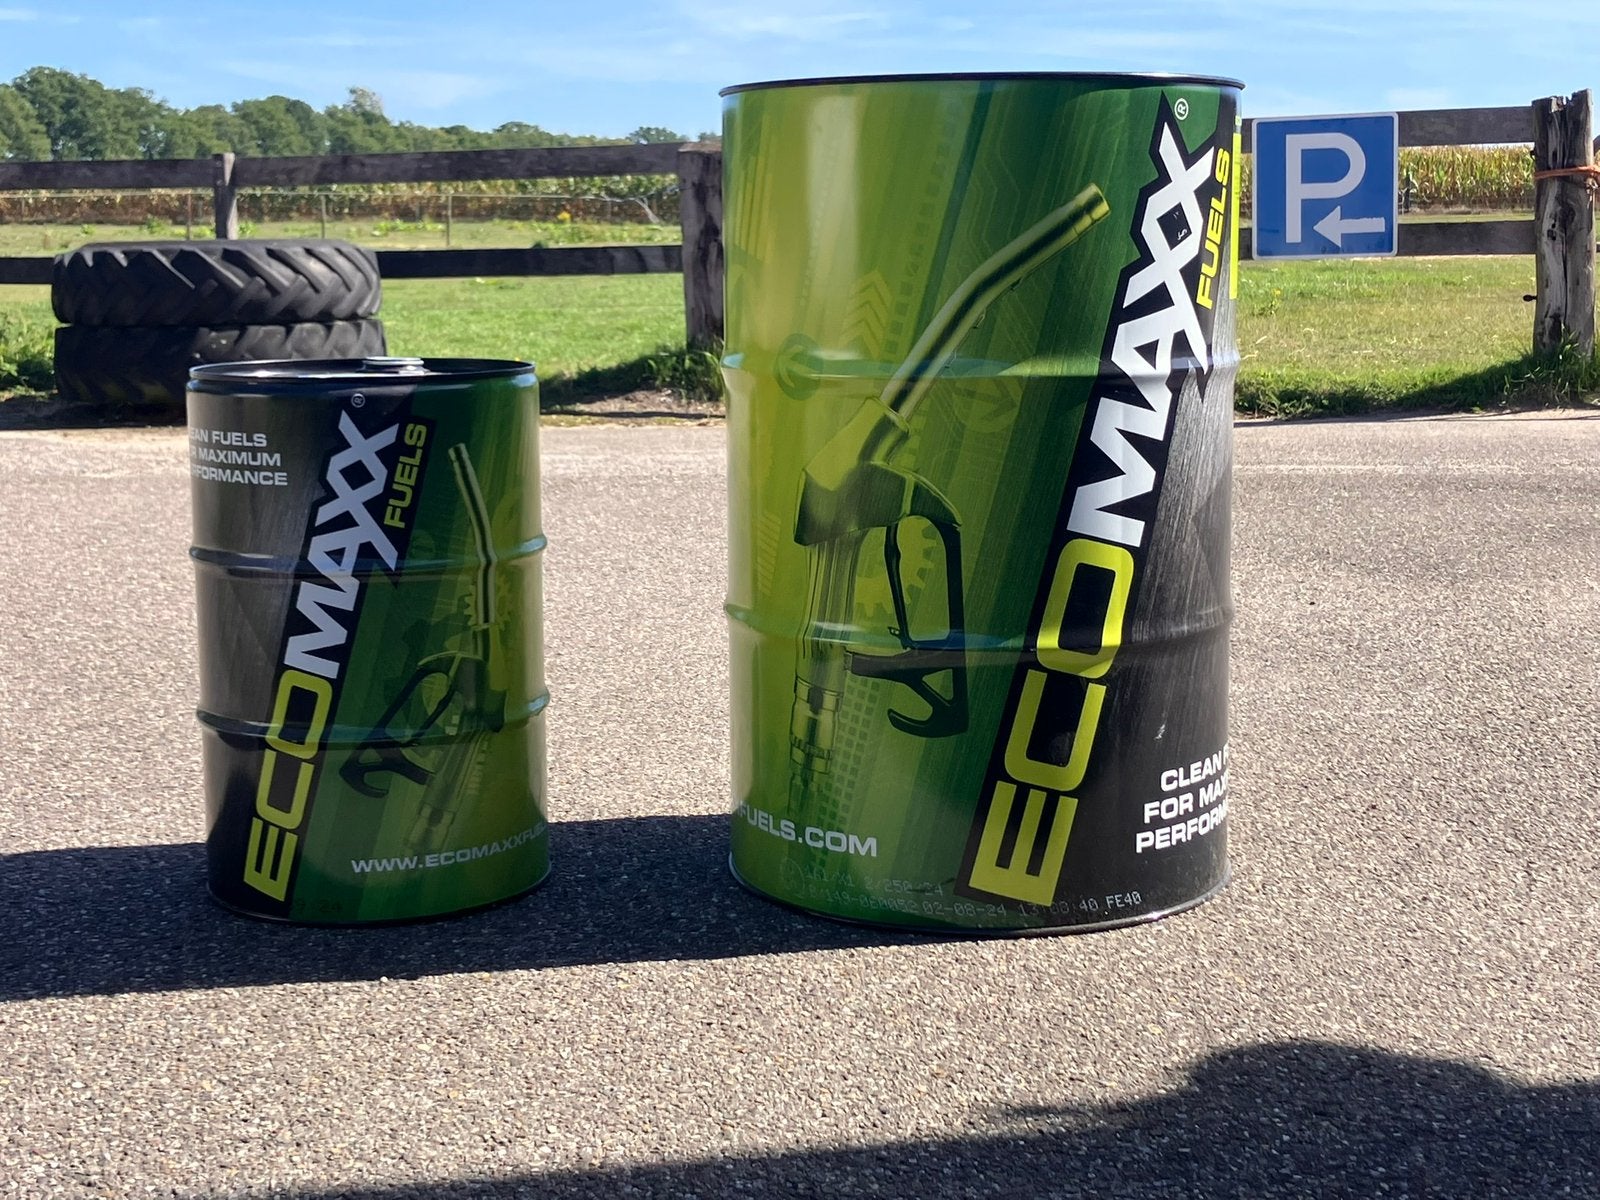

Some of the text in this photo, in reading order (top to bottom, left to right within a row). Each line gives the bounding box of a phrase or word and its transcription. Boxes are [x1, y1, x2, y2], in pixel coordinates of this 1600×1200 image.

[1285, 131, 1367, 244] P
[1196, 147, 1231, 310] FUELS
[198, 447, 282, 468] MAXIMUM
[211, 430, 268, 448] FUELS
[384, 422, 428, 528] FUELS
[968, 121, 1214, 908] ECOMAXX
[243, 409, 400, 902] ECOMAXX
[1160, 750, 1222, 792] CLEAN
[737, 799, 878, 858] FUELS.COM
[1143, 792, 1194, 825] FOR
[1105, 890, 1143, 911] FE40
